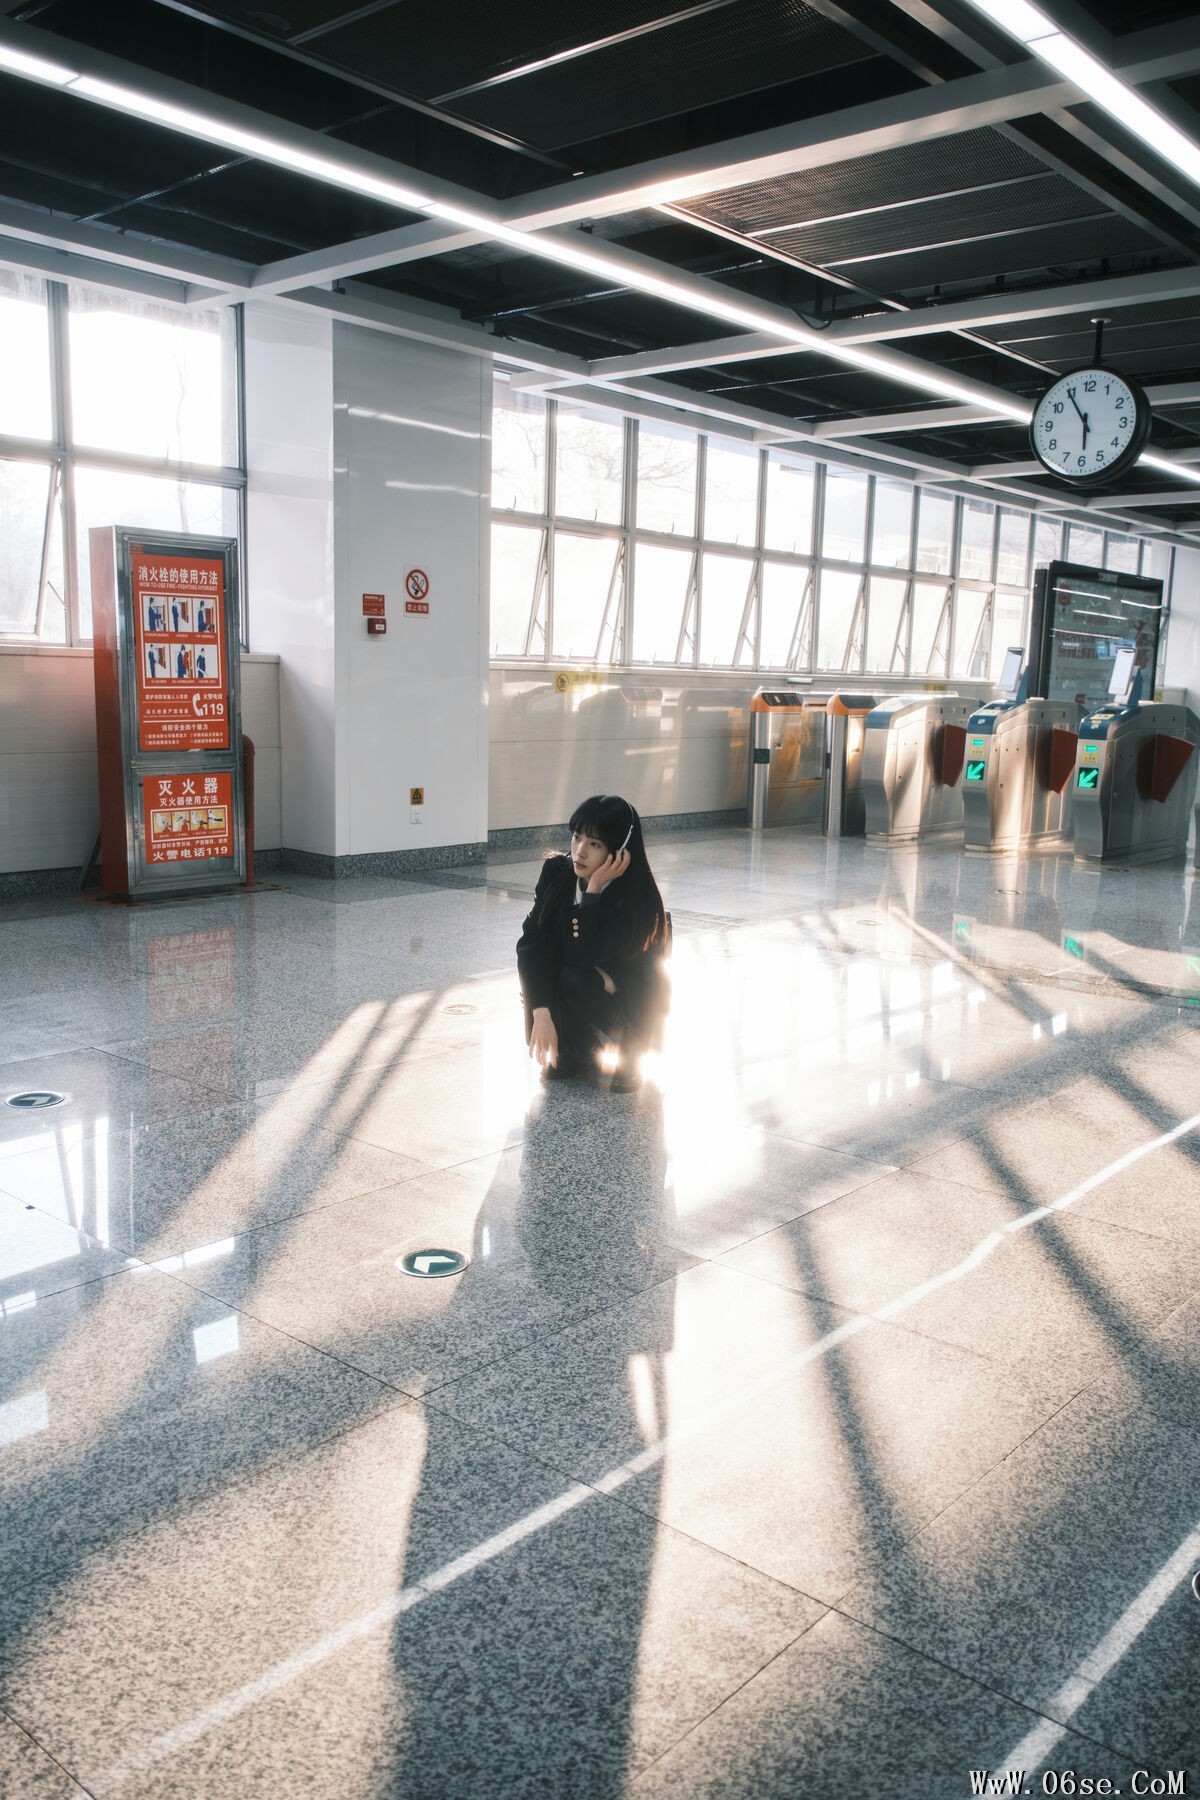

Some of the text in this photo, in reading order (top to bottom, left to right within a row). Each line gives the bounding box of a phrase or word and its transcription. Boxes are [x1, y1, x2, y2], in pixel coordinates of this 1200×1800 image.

[1083, 380, 1097, 393] 12
[1104, 384, 1110, 396] 1
[1053, 402, 1064, 414] 10
[1115, 397, 1125, 409] 2
[1045, 420, 1053, 432] 9
[1119, 417, 1128, 429] 3
[1048, 439, 1057, 450] 8
[1110, 436, 1119, 448] 4
[1062, 452, 1071, 463] 7
[1077, 455, 1086, 467] 6
[1095, 450, 1104, 462] 5
[138, 565, 218, 585] 消火栓的使用方法
[202, 703, 224, 715] 119
[158, 777, 218, 796] 灭火器
[159, 795, 218, 807] 灭火器使用方法
[152, 846, 228, 861] 火警电话119
